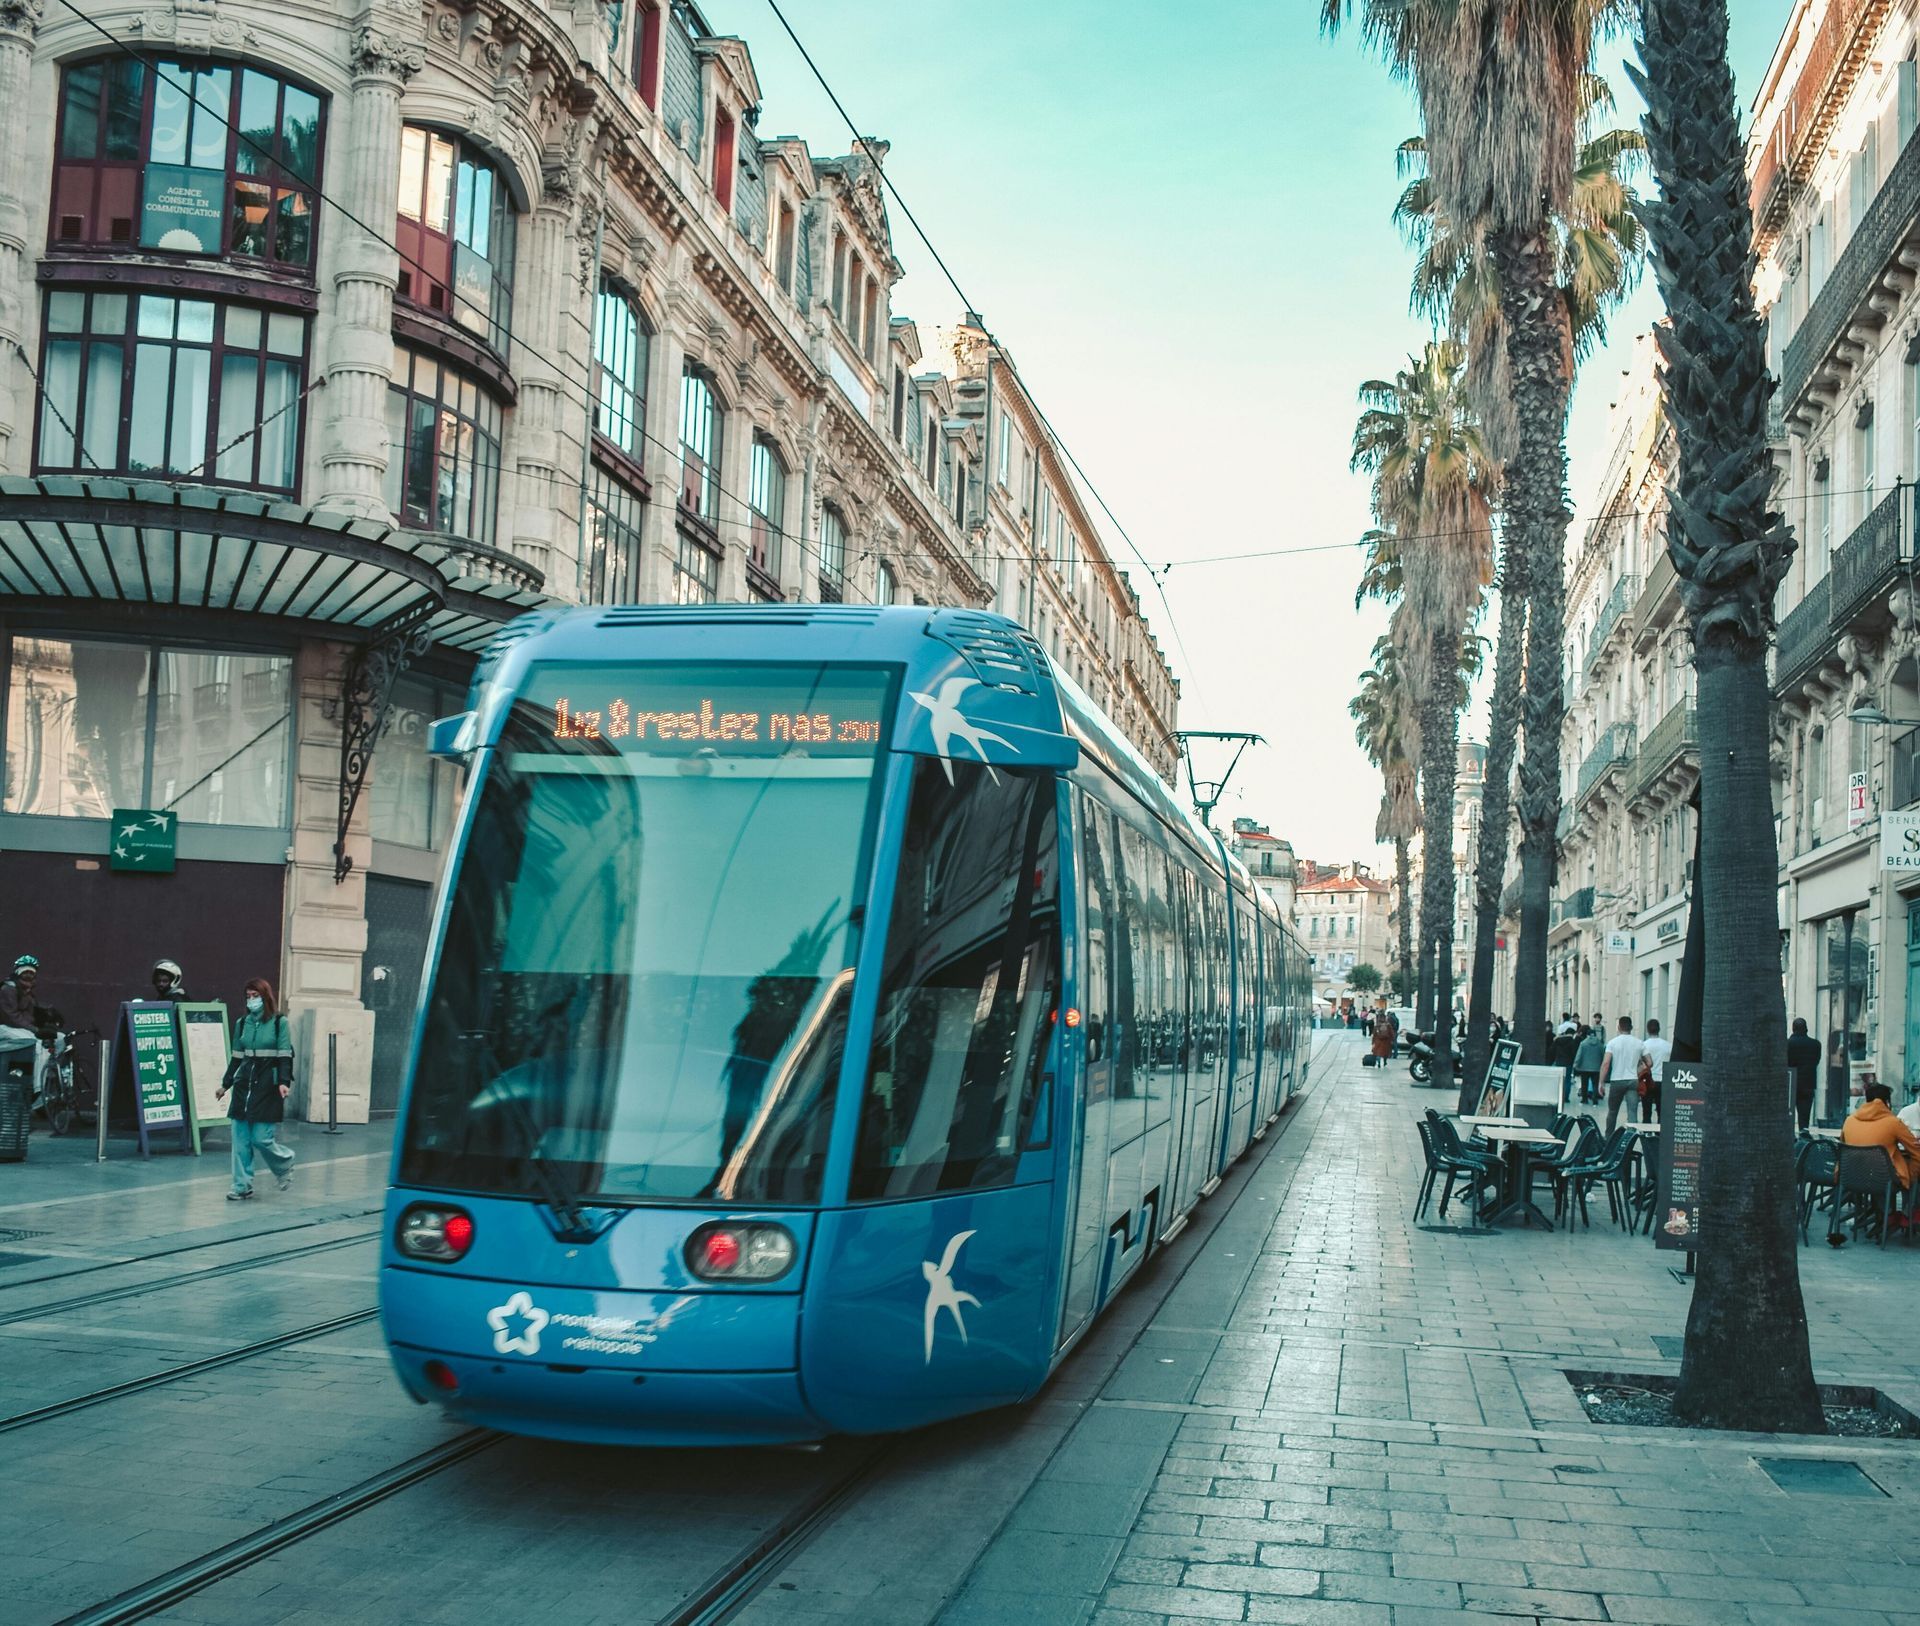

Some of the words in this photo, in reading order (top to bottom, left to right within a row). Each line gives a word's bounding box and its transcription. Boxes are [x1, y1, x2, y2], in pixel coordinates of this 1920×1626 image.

[167, 187, 202, 197] AGENCE
[158, 195, 195, 206] CONSEIL
[196, 199, 209, 207] EN
[145, 203, 220, 218] COMMUNICATION
[636, 699, 759, 740] restez
[1888, 816, 1920, 825] SENE
[133, 1013, 170, 1025] CHISTERA
[136, 1036, 156, 1051] HAPPY
[155, 1035, 173, 1050] HOUR
[139, 1061, 156, 1071] PINTE
[1671, 1069, 1698, 1083] حلال
[142, 1082, 163, 1092] MOJITO
[1674, 1082, 1694, 1090] HALAL
[148, 1093, 167, 1103] VIRGIN
